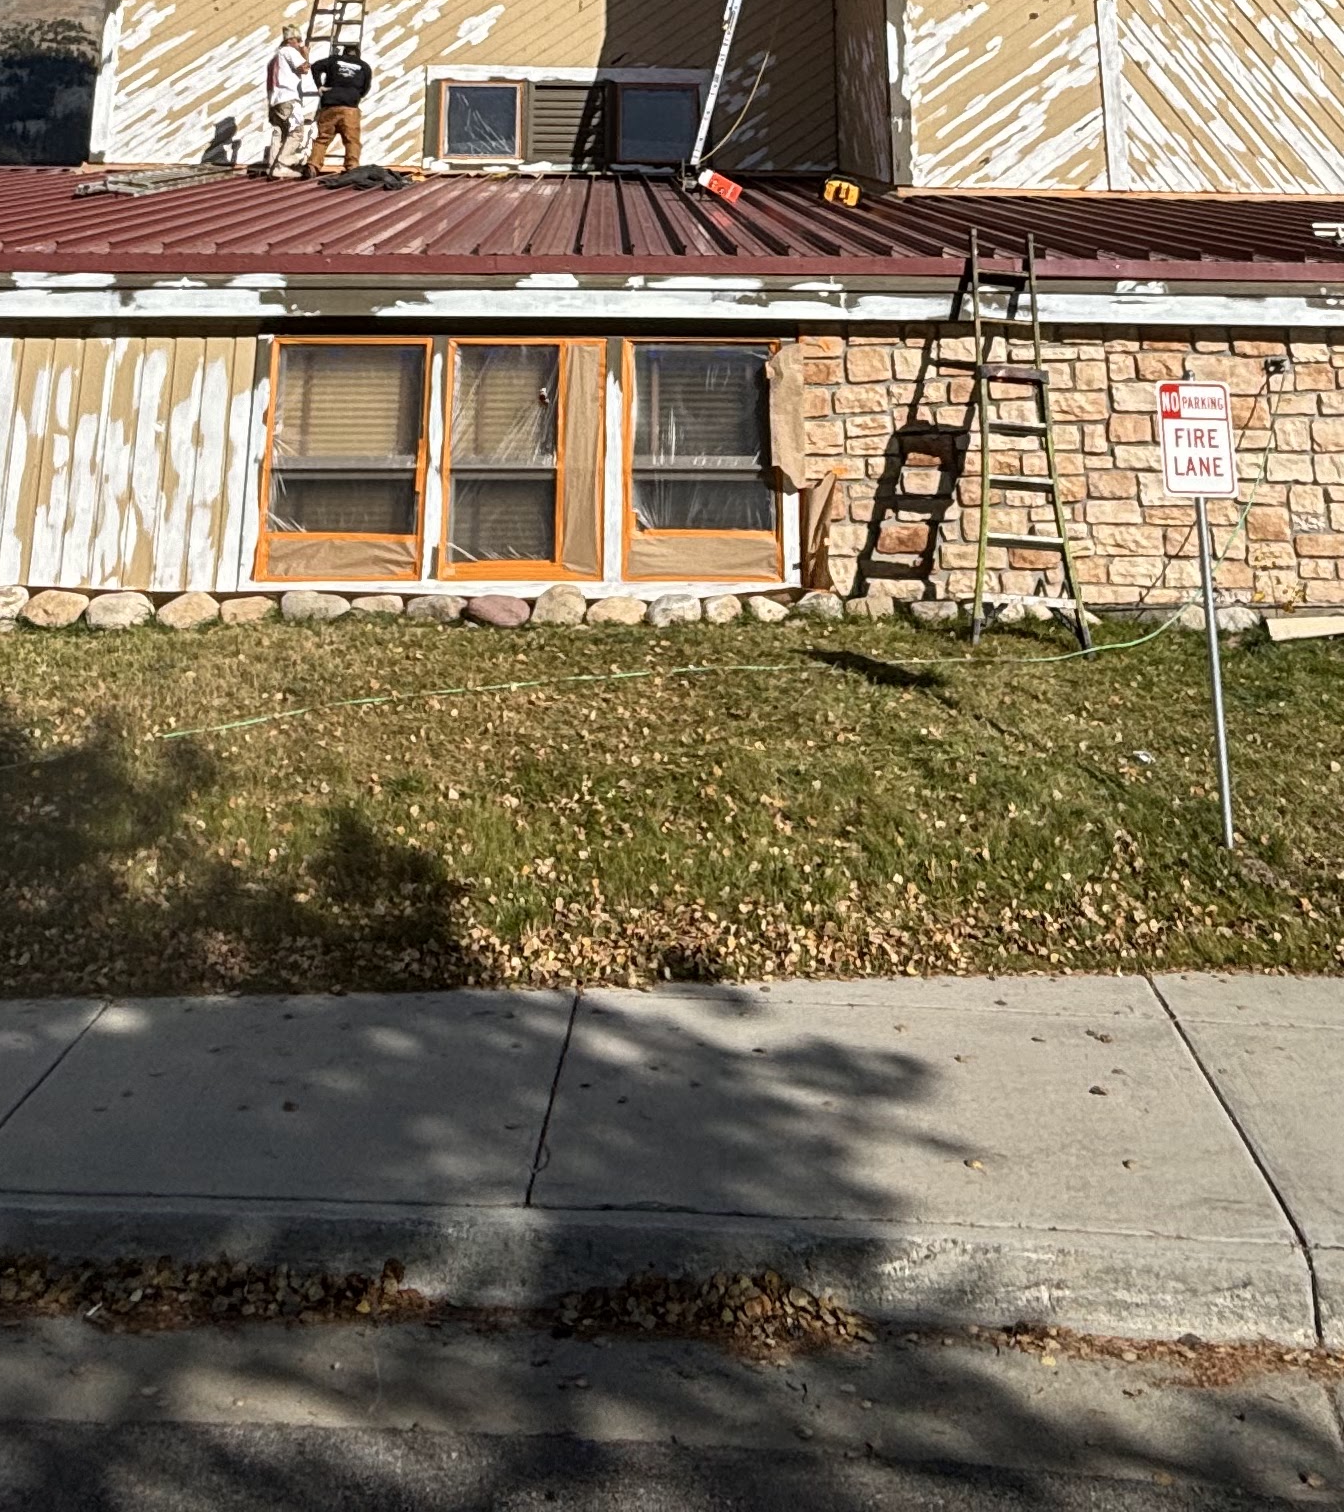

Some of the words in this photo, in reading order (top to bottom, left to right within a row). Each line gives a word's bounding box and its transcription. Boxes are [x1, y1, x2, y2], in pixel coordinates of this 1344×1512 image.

[1161, 391, 1180, 413] NO
[1181, 397, 1224, 411] PARKING
[1174, 428, 1220, 449] FIRE
[1173, 456, 1225, 477] LANE
